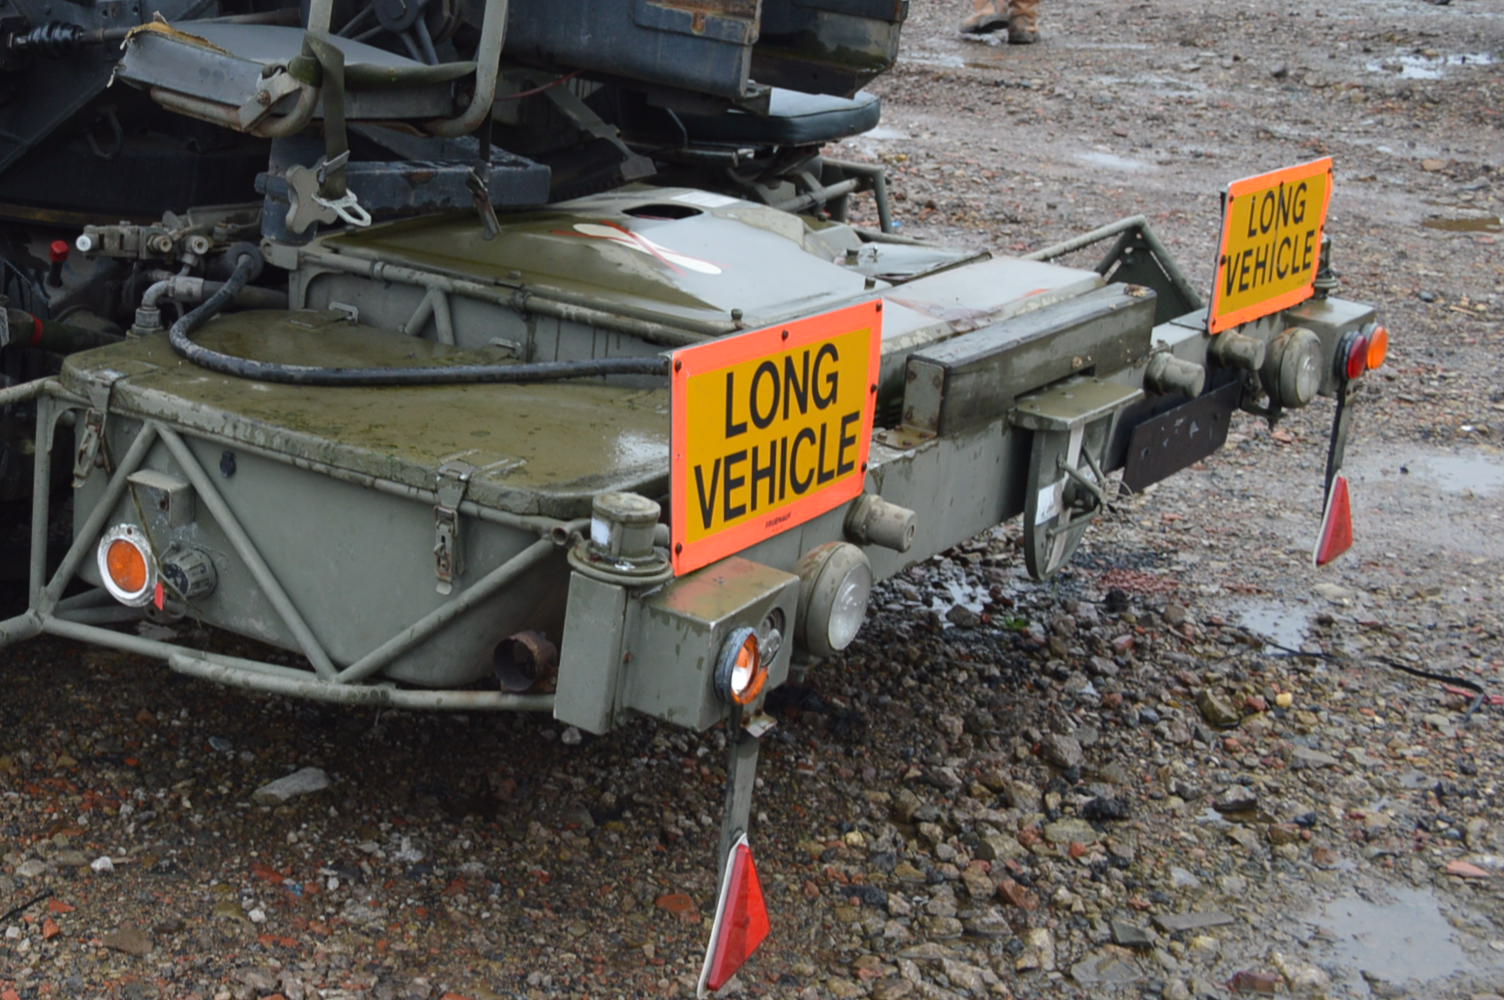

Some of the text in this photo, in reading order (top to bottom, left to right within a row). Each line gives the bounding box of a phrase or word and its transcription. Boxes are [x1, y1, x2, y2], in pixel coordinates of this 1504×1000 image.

[1248, 181, 1308, 239] LONG
[1226, 229, 1316, 297] VEHICLE
[725, 342, 840, 440] LONG
[693, 410, 861, 531] VEHICLE
